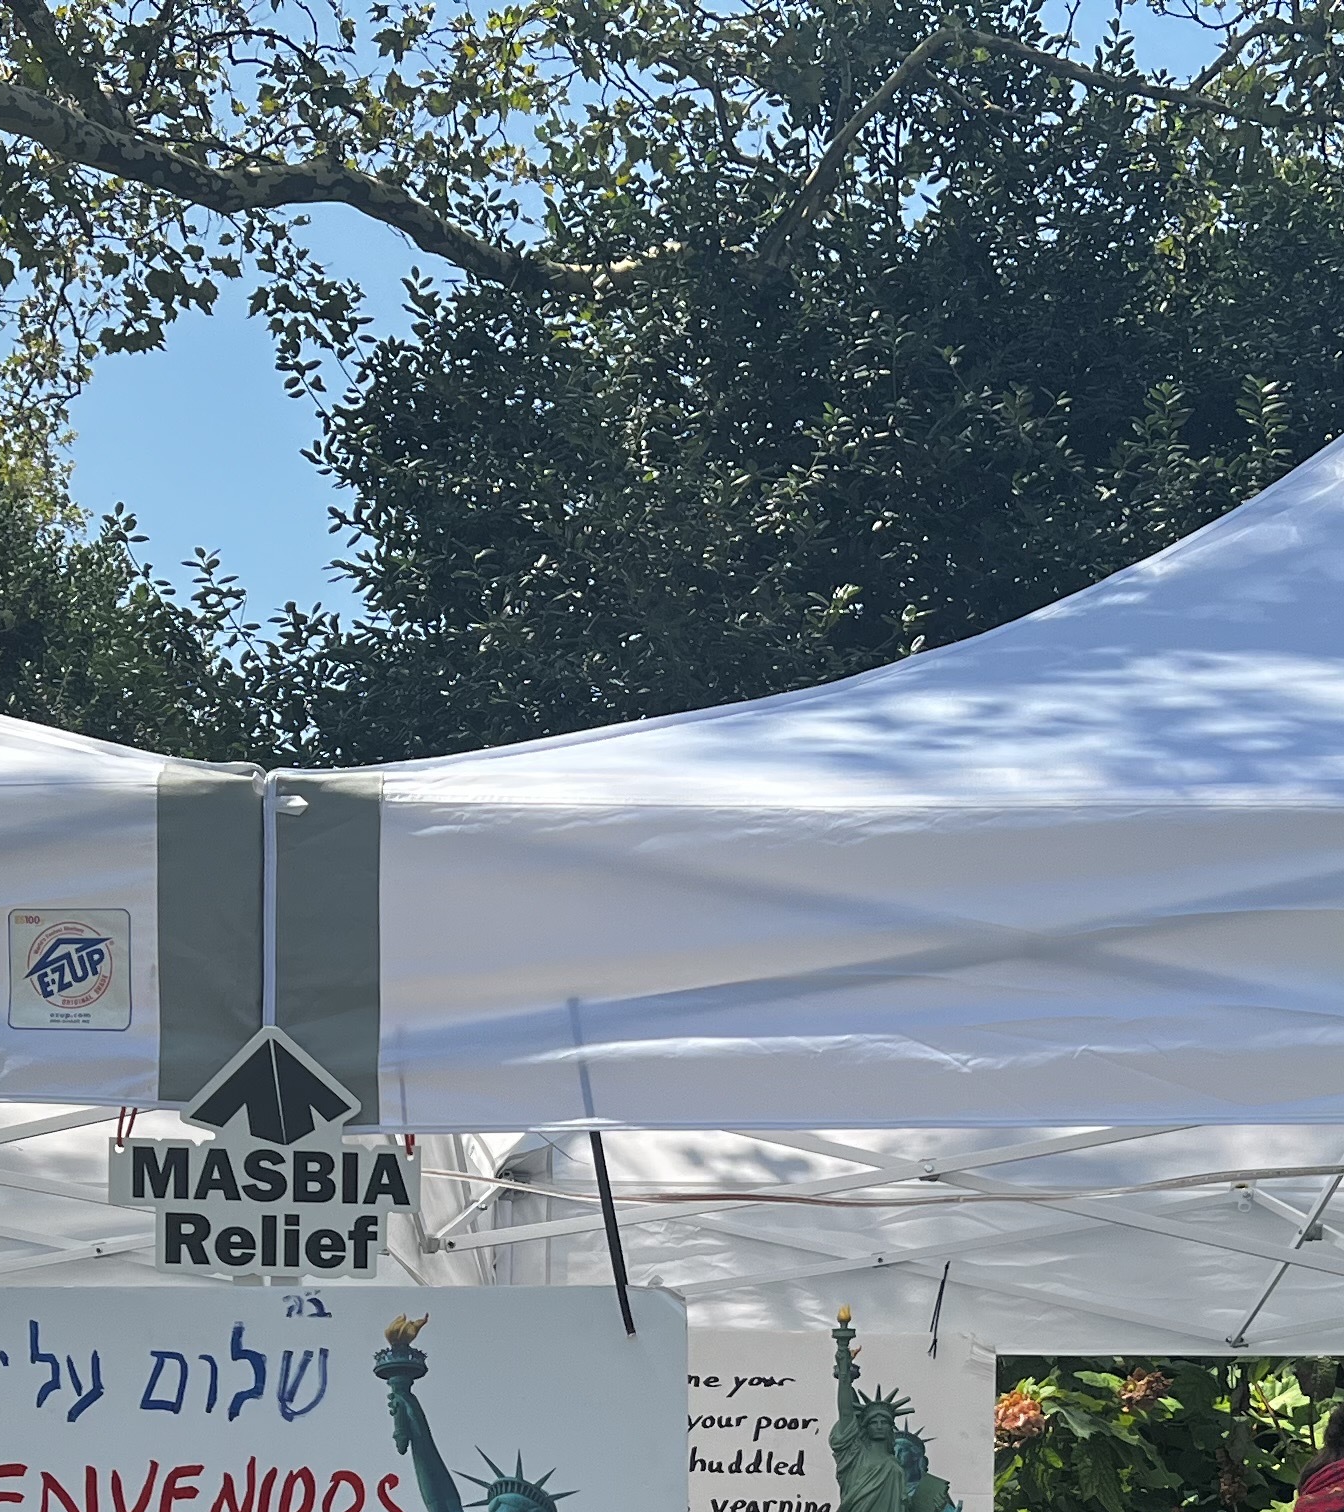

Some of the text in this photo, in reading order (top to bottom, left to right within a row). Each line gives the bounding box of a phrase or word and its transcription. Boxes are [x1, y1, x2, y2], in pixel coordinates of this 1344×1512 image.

[132, 1146, 411, 1206] MASBIA
[165, 1212, 378, 1269] Relief
[139, 1320, 331, 1423] שלום
[726, 1375, 796, 1398] your
[688, 1414, 819, 1441] your poor,
[689, 1447, 805, 1476] huddled
